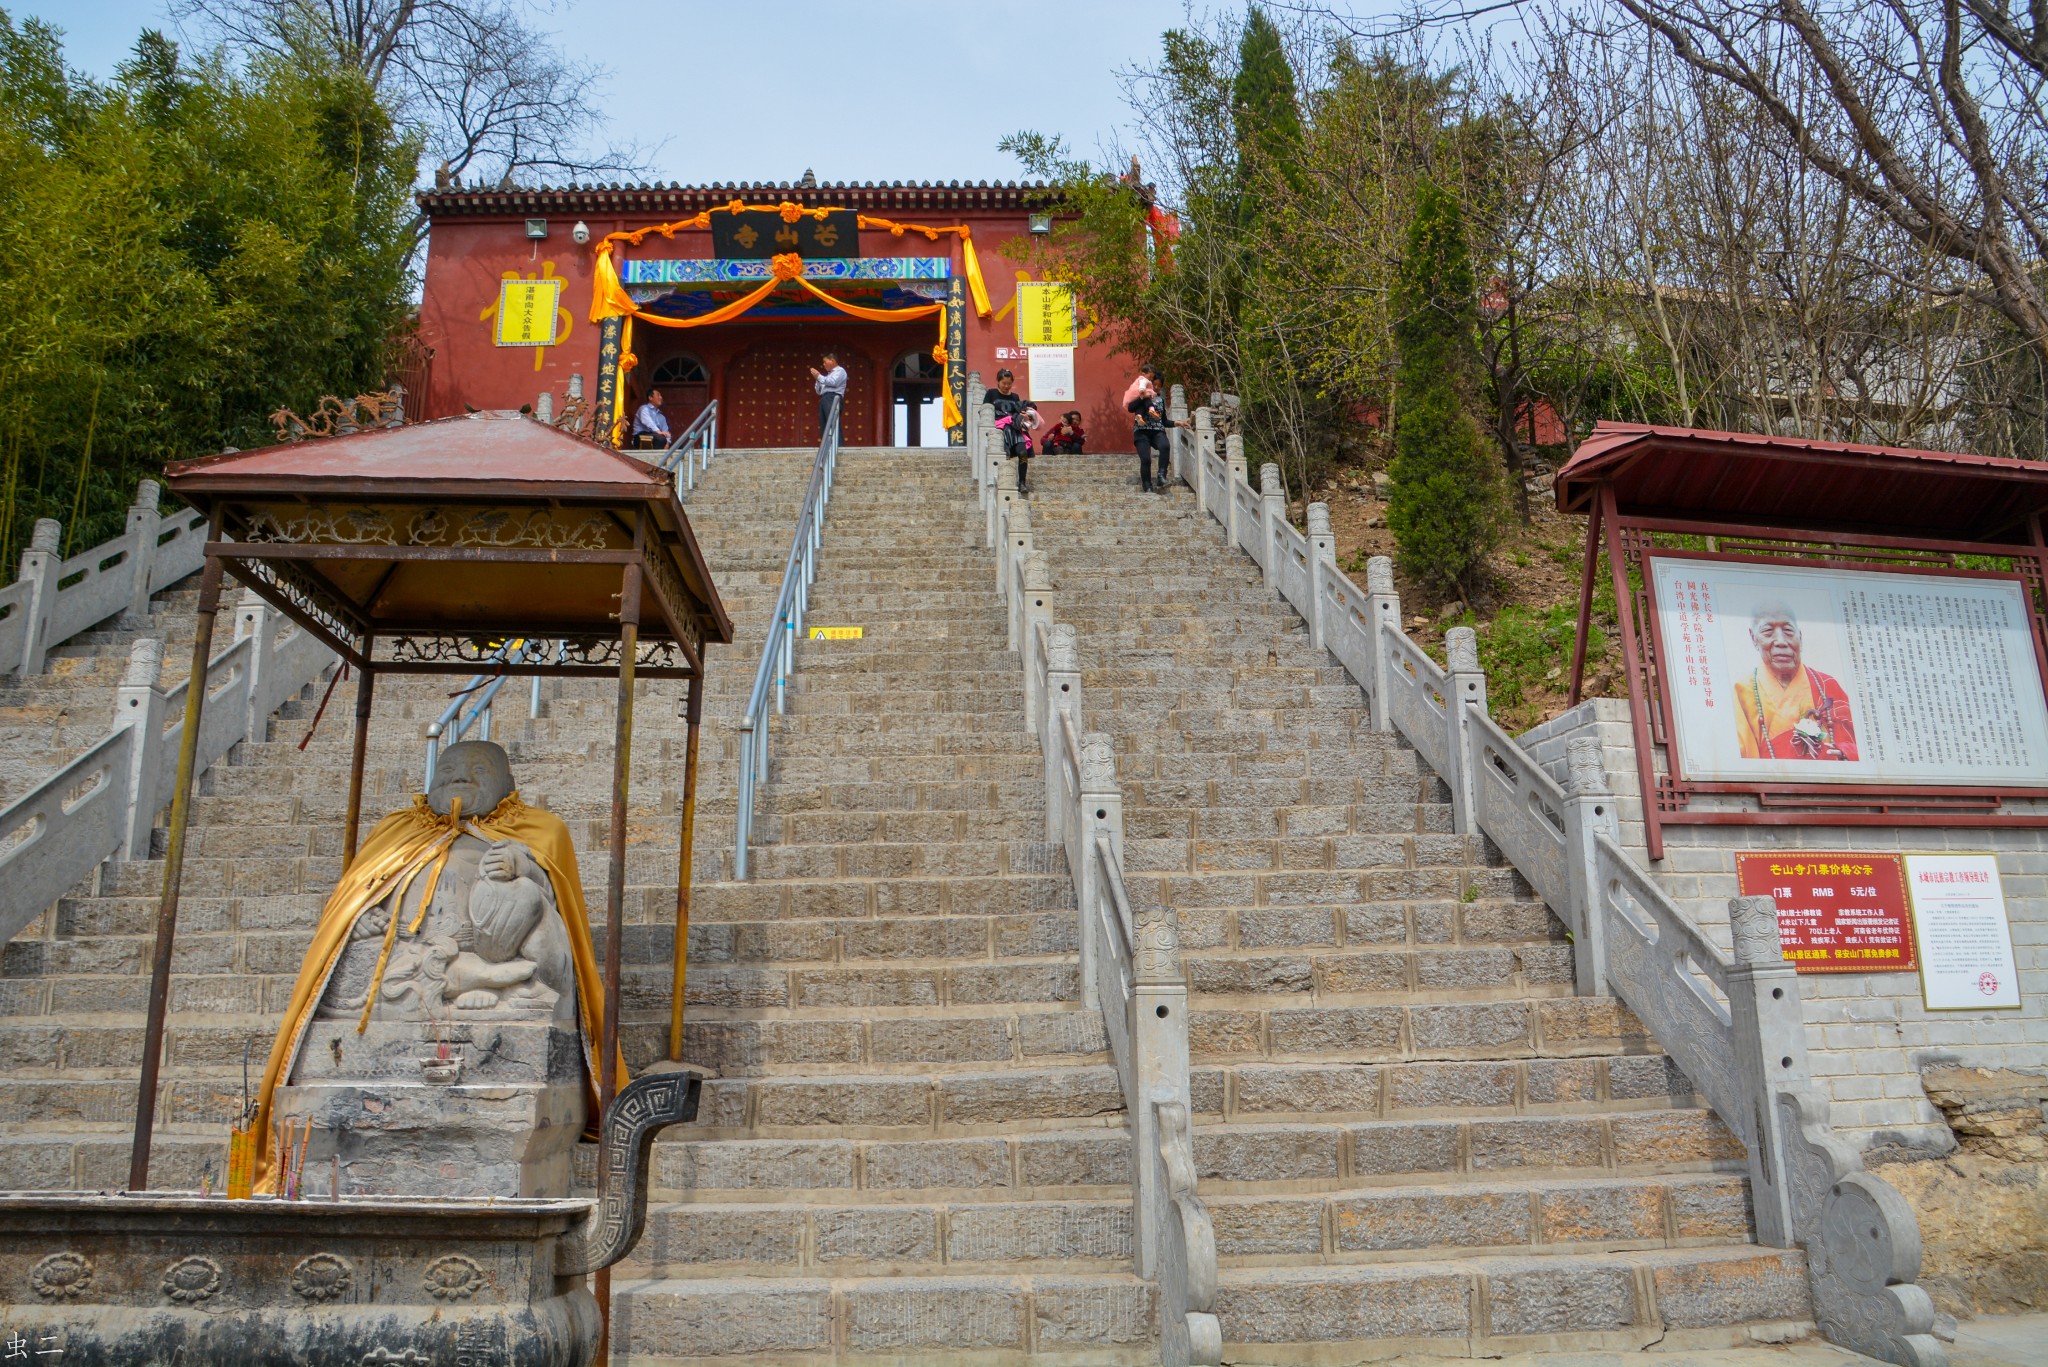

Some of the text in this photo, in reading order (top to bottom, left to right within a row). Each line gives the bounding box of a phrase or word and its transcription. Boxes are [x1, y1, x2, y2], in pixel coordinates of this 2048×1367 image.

[1010, 348, 1028, 356] 入口
[1701, 582, 1714, 623] 真华长老
[1674, 580, 1698, 686] 台湾中道学苑开山住持
[1770, 864, 1873, 875] 芒山寺门票价格公示
[1773, 886, 1878, 898] 门票 RMB 5元/位
[1808, 927, 1842, 935] 70以上老人
[1853, 927, 1901, 935] 河南省老年优待证
